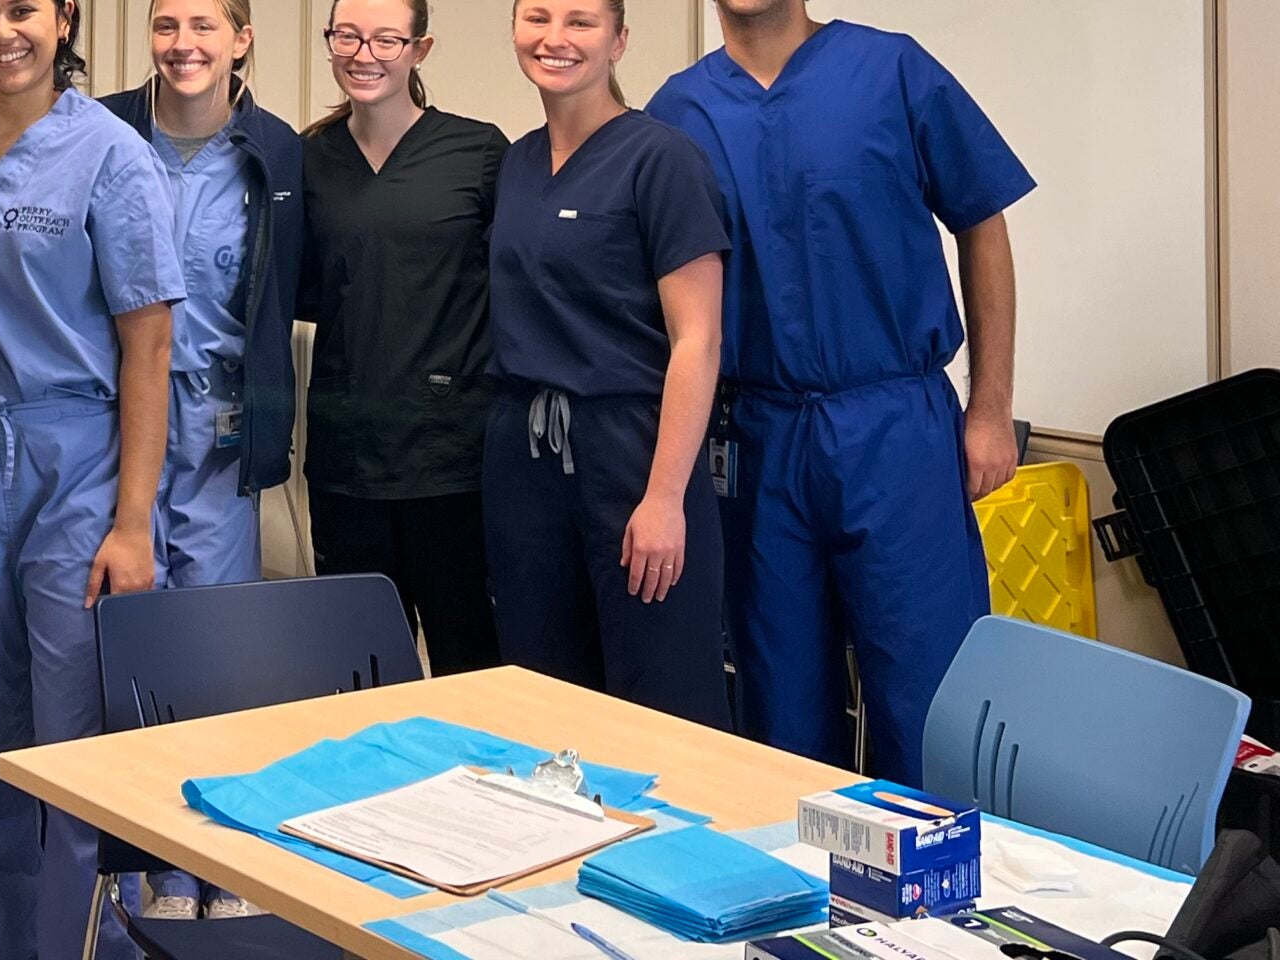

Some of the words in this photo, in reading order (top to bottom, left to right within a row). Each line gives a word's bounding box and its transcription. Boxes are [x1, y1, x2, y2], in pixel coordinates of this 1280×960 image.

[21, 206, 53, 216] PERRY
[19, 214, 70, 228] OUTREACH
[16, 223, 64, 236] PROGRAM
